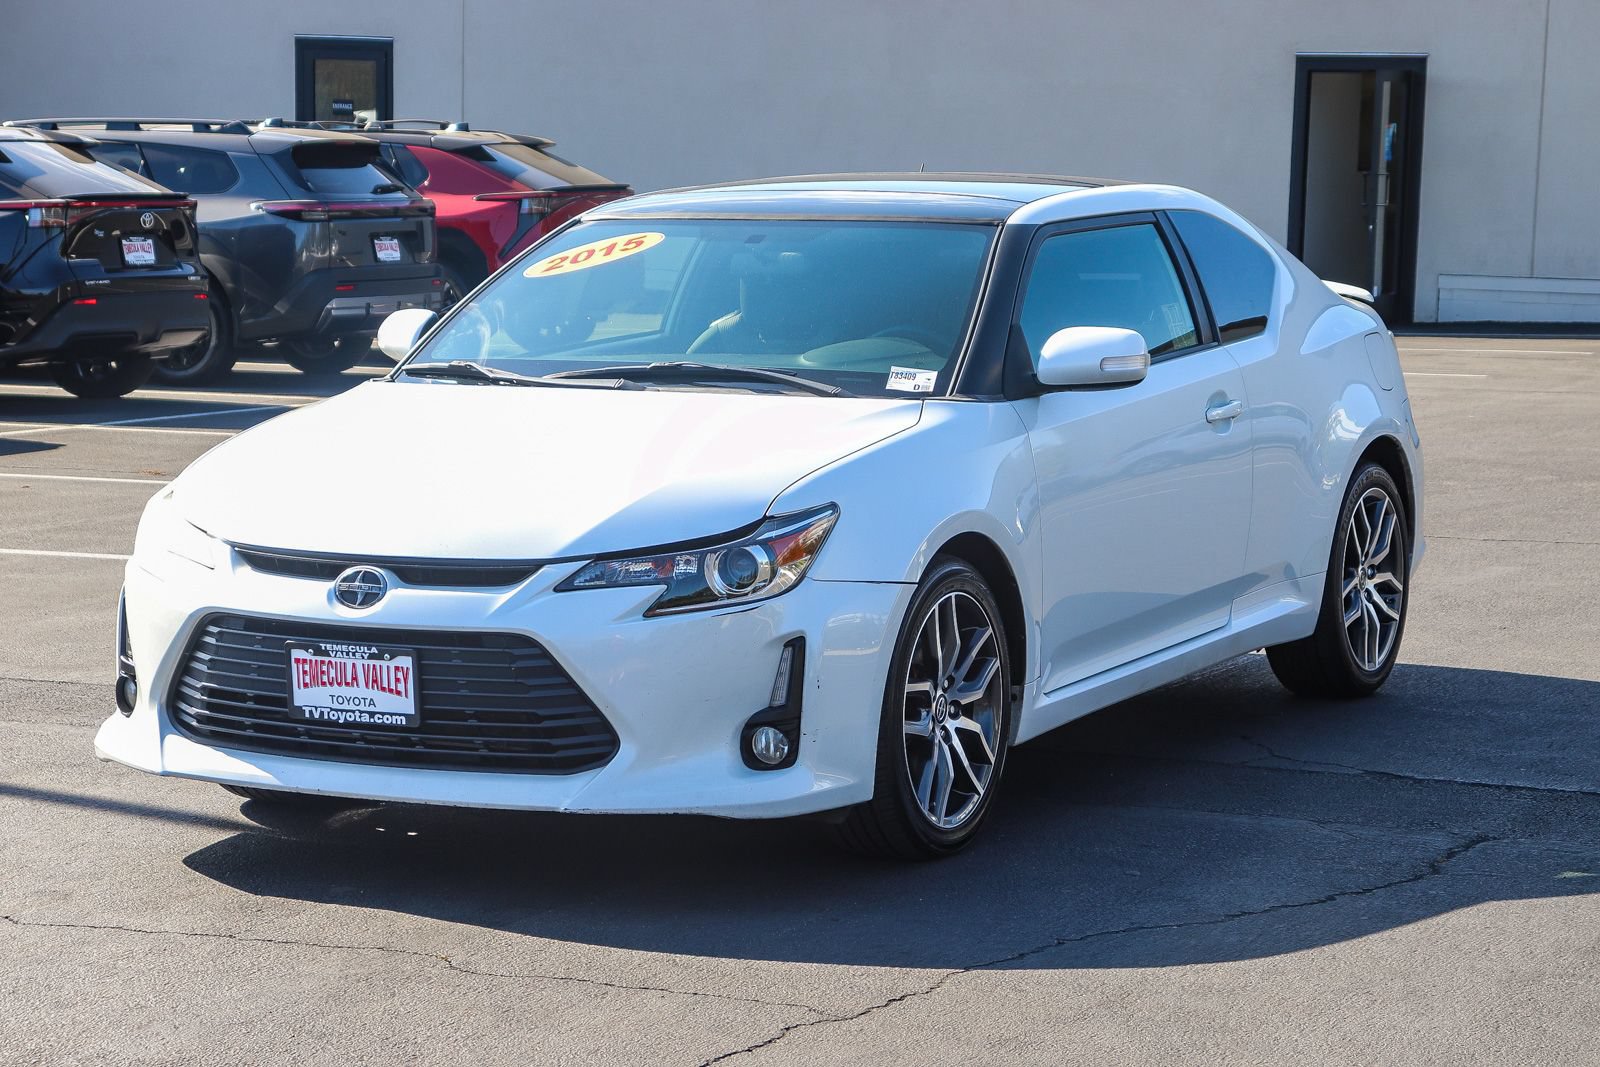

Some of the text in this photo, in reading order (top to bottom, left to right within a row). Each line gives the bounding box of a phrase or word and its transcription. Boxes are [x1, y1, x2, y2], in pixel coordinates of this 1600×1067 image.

[541, 235, 648, 273] 2015
[319, 643, 378, 654] TEMECULA
[329, 651, 370, 660] VALLEY
[294, 657, 410, 699] TEMECULA VALLEY
[329, 694, 376, 708] TOYOTA
[302, 706, 406, 725] TVToyota.com
